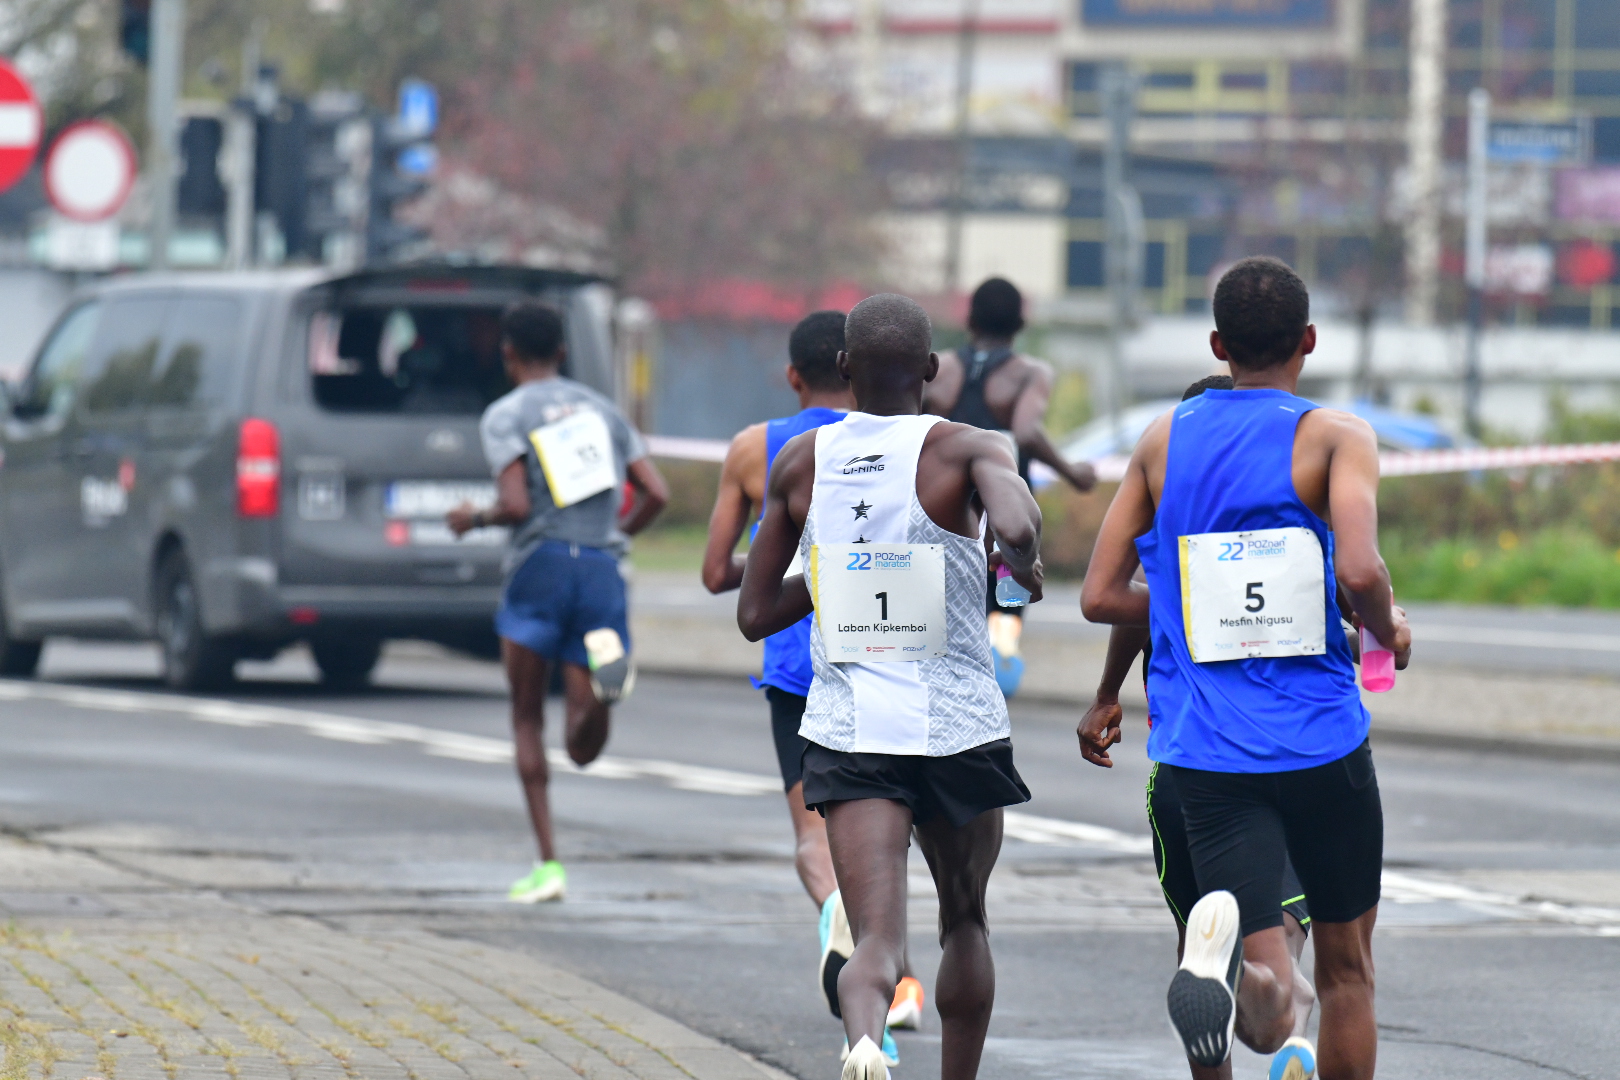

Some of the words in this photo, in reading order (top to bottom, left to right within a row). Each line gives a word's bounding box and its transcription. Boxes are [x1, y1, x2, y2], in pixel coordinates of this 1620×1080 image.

[843, 464, 885, 475] LI-NING
[1217, 542, 1244, 560] 22
[1247, 547, 1285, 556] maraton
[846, 552, 872, 570] 22
[875, 560, 911, 568] maraton
[1244, 581, 1265, 613] 5
[874, 591, 888, 620] 1
[1220, 617, 1253, 628] Mesfin
[1256, 615, 1293, 627] Nigusu
[838, 623, 870, 632] Laban
[873, 623, 927, 634] Kipkemboi
